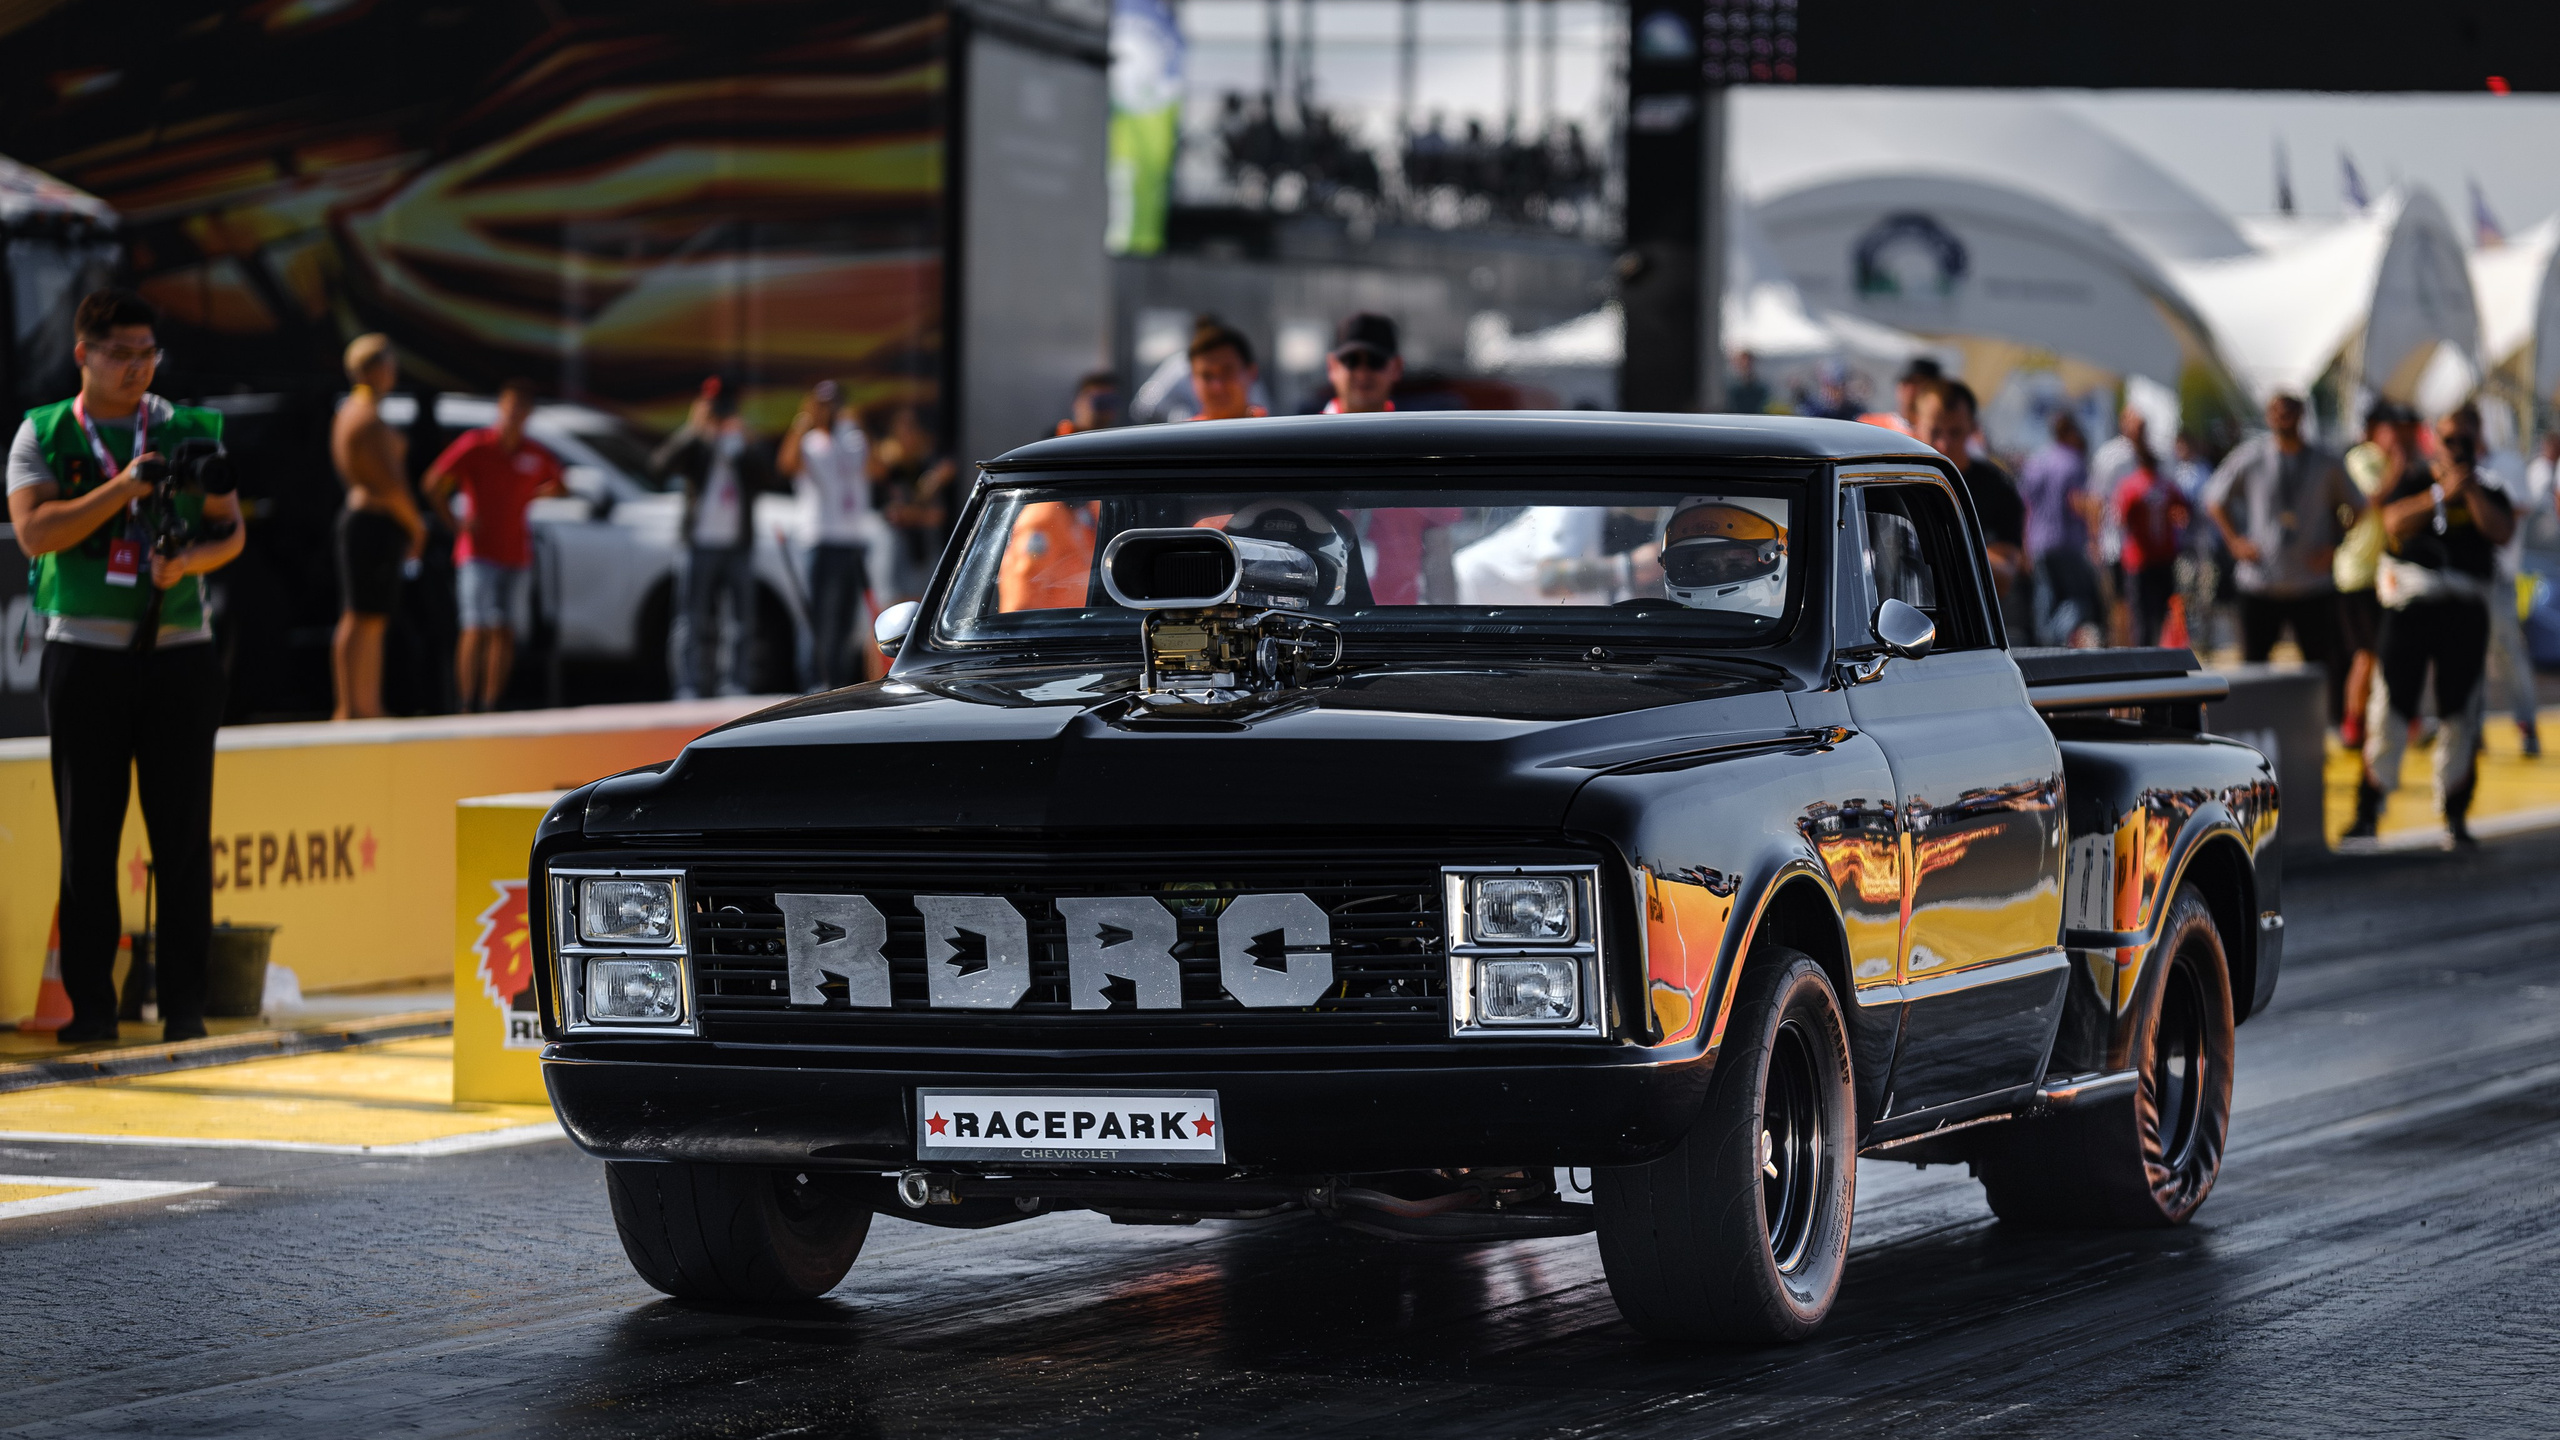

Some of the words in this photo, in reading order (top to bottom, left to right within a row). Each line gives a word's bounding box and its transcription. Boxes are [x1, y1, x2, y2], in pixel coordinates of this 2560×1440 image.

[775, 893, 1334, 1009] RDRC
[953, 1111, 1189, 1139] RACEPARK
[1021, 1149, 1119, 1159] CHEVROLET
